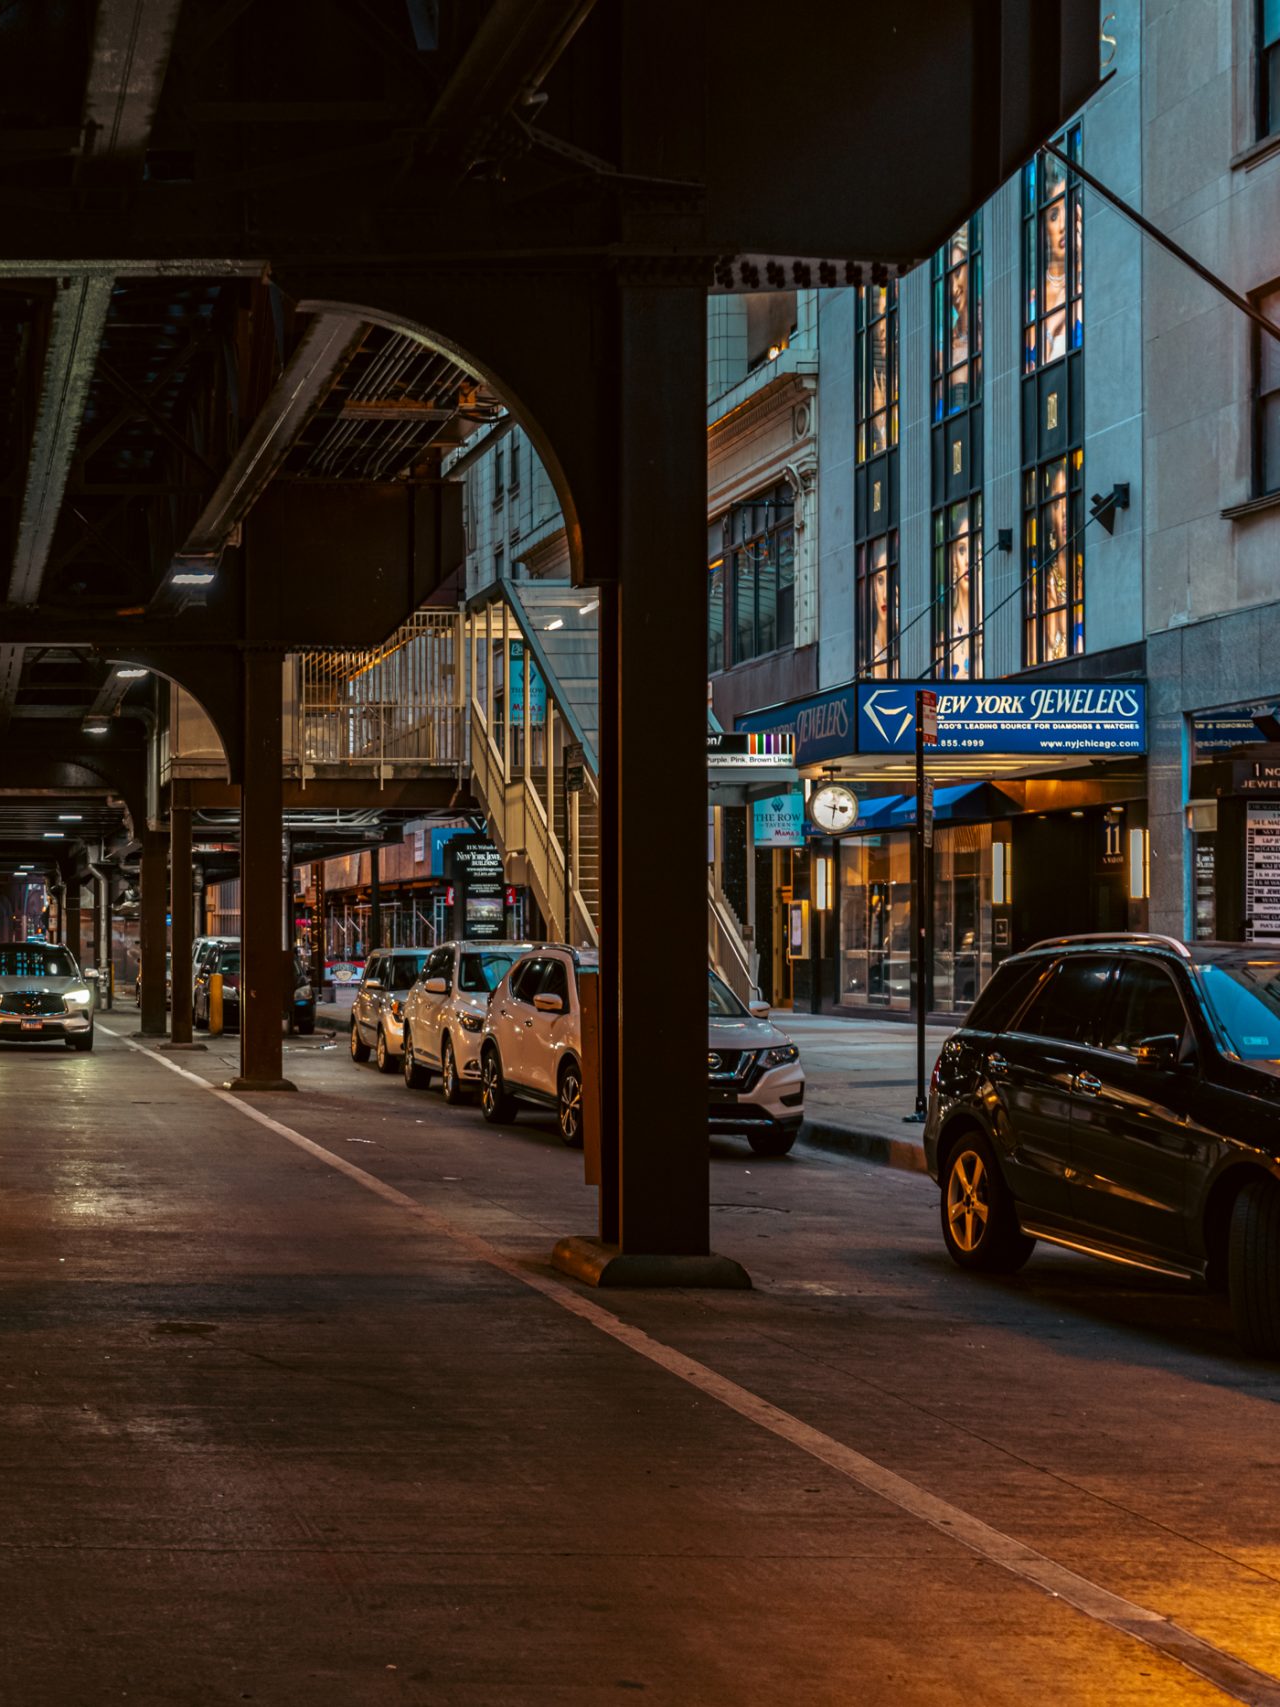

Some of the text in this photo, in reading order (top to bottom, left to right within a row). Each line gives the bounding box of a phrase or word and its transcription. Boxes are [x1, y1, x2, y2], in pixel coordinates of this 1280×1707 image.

[975, 695, 1026, 714] YORK
[1030, 689, 1139, 720] JEWELERS
[796, 698, 849, 753] JEWELERS
[1039, 739, 1140, 749] www.nyjchicago.com
[748, 756, 772, 764] Brown
[773, 756, 793, 764] Lines
[1241, 779, 1280, 789] JEWE
[754, 813, 801, 822] THE ROW
